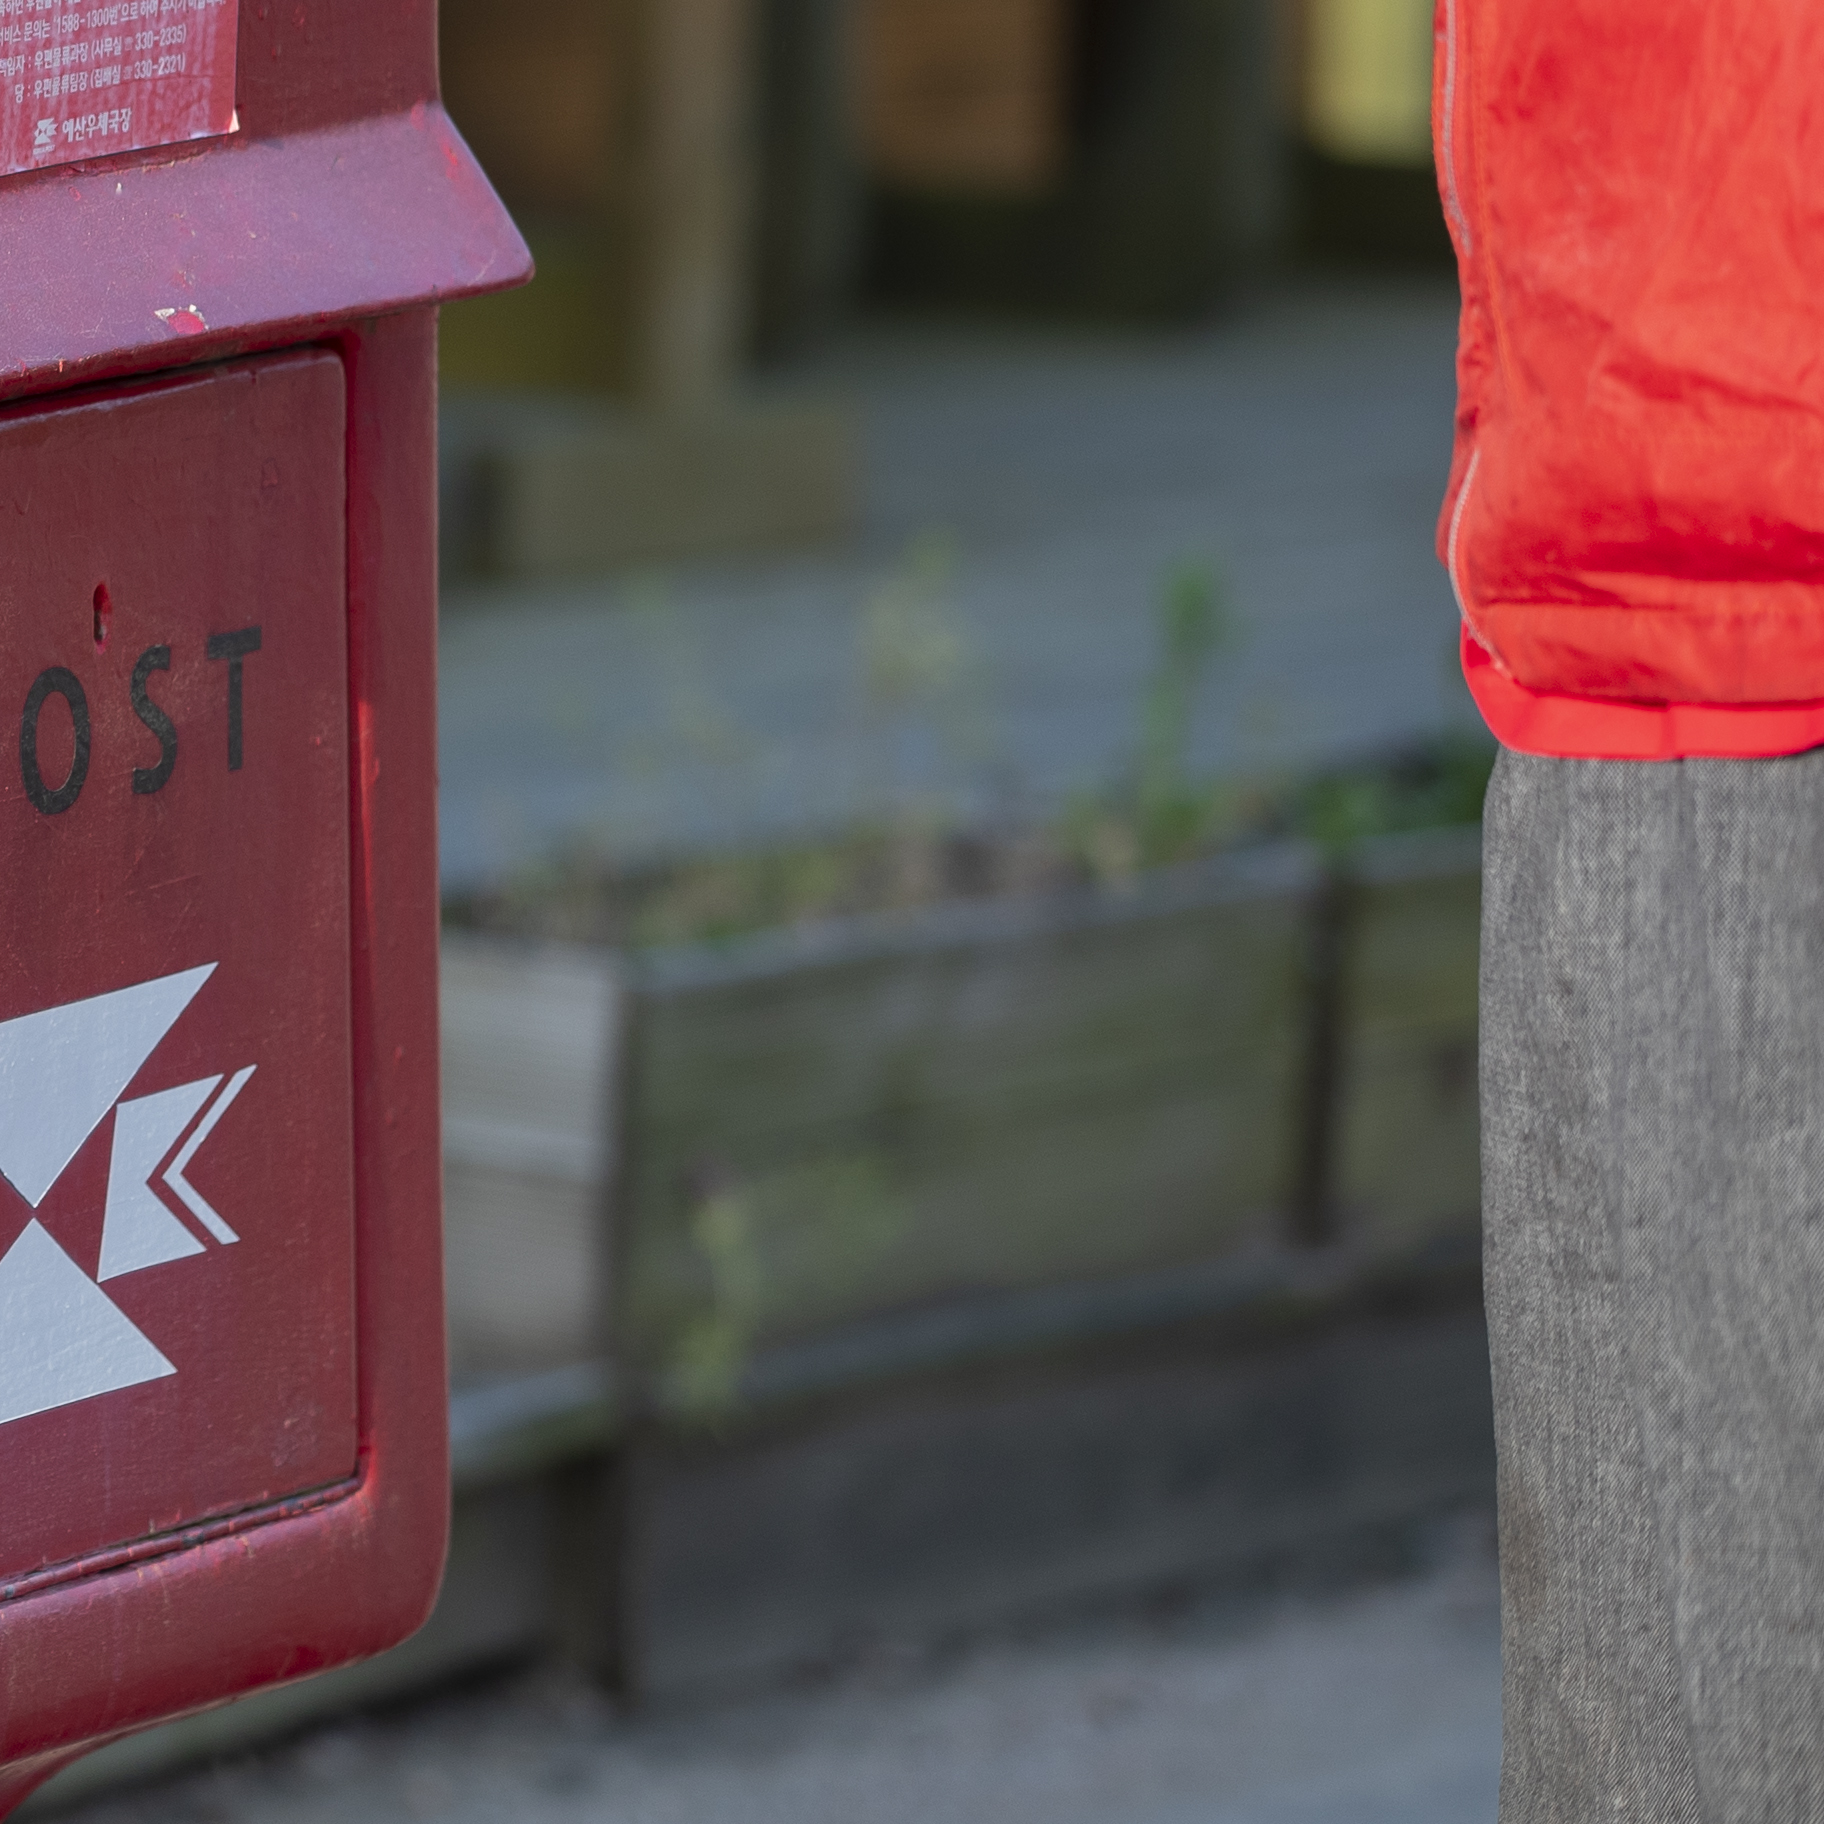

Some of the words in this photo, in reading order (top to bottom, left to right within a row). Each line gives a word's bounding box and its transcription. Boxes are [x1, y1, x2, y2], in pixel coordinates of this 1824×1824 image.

[23, 19, 50, 41] 문의는
[34, 42, 88, 69] 우편물류과장
[90, 36, 121, 59] (사무실
[135, 23, 186, 50] 330-2335)
[33, 71, 87, 98] 우편물류팀장
[90, 64, 120, 87] (집배실
[134, 52, 186, 78] 330-2321)
[61, 108, 131, 141] 예산우체국장
